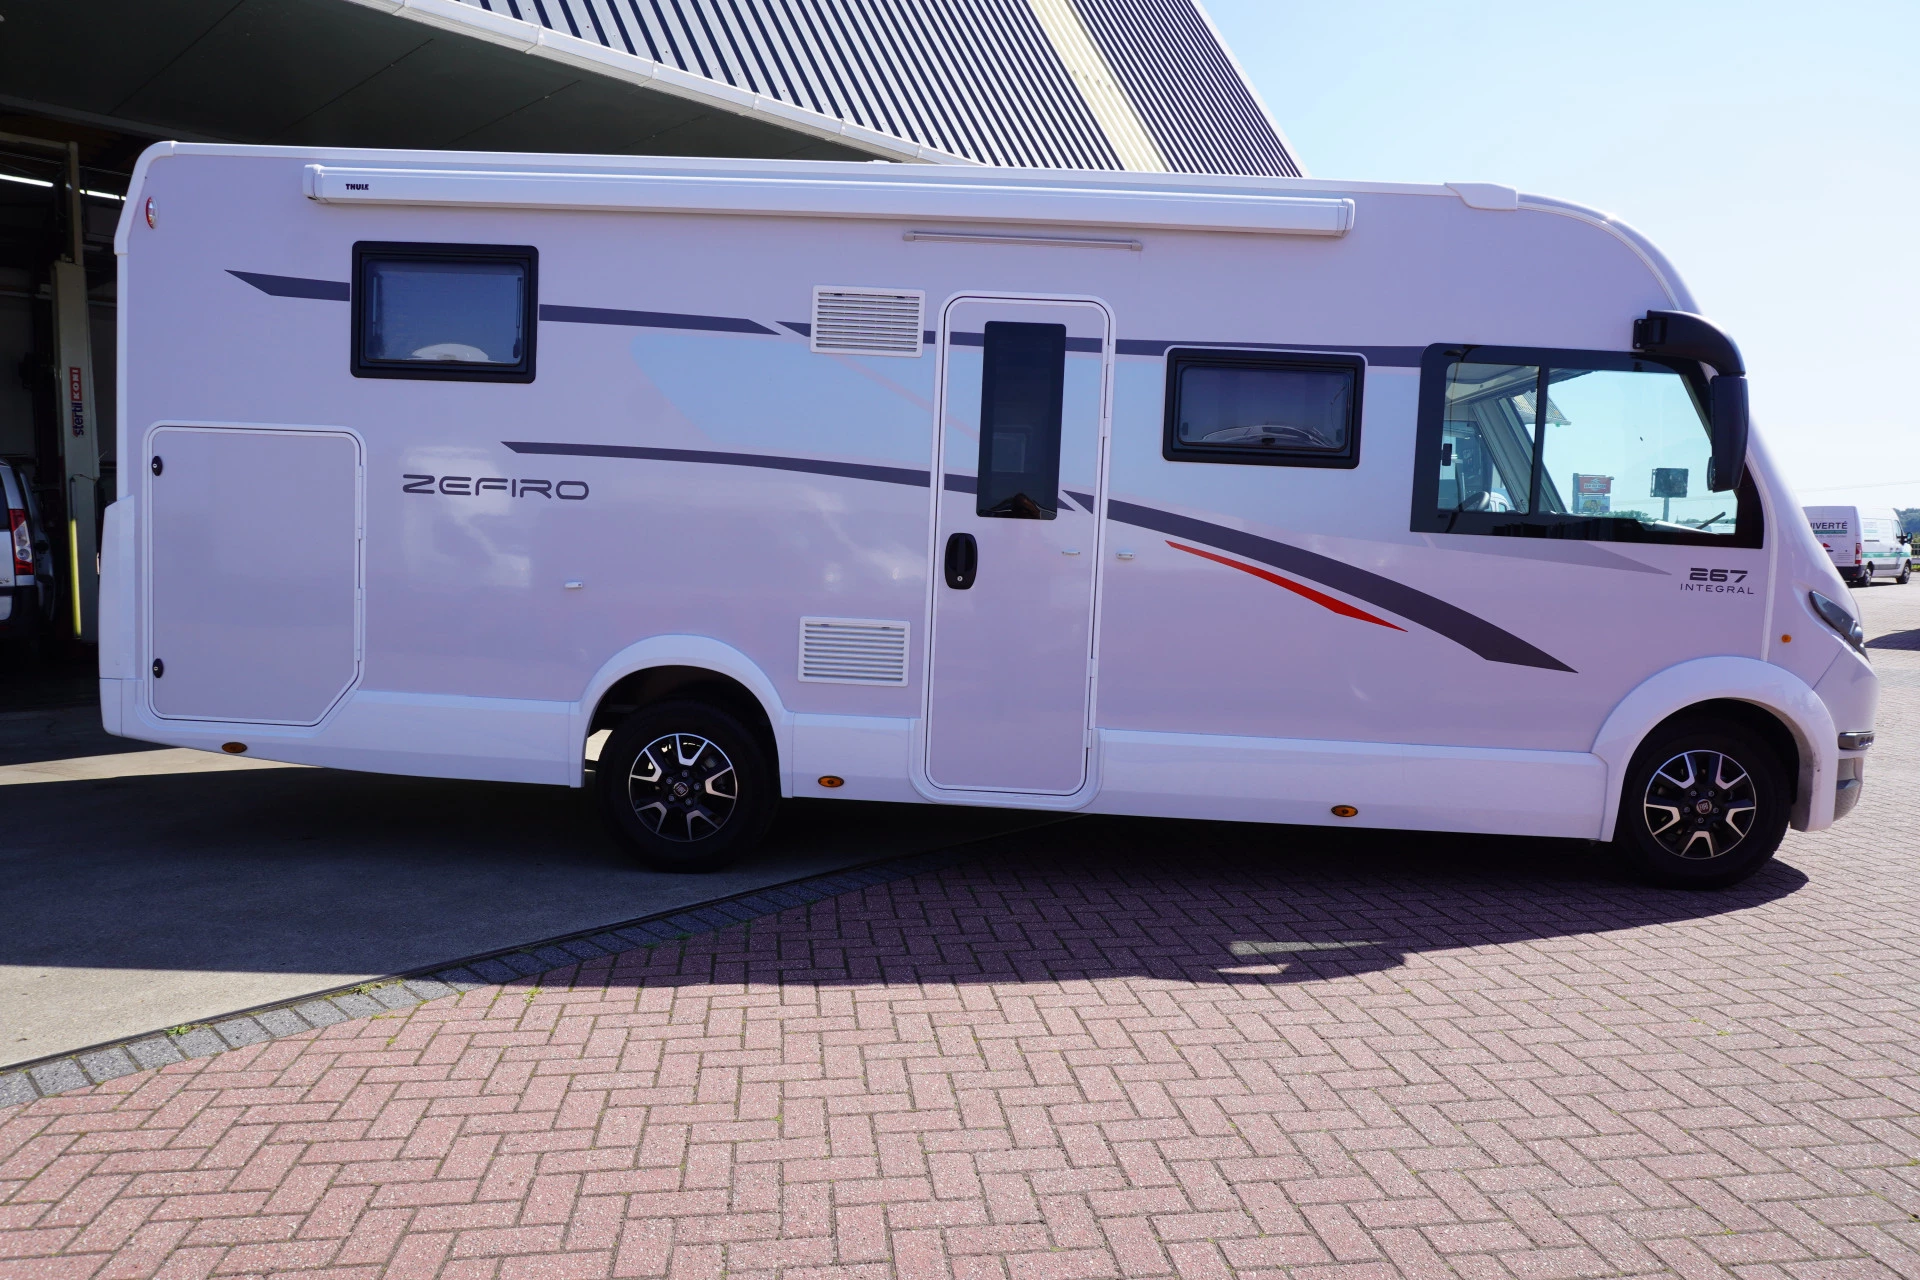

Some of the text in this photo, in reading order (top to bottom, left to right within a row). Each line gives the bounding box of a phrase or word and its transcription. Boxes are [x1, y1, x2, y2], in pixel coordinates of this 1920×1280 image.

[345, 183, 369, 191] THULE
[71, 369, 84, 436] stertil KONI
[402, 474, 590, 501] ZEFIRO
[1689, 567, 1748, 583] 267
[1680, 583, 1754, 595] INTEGRAL
